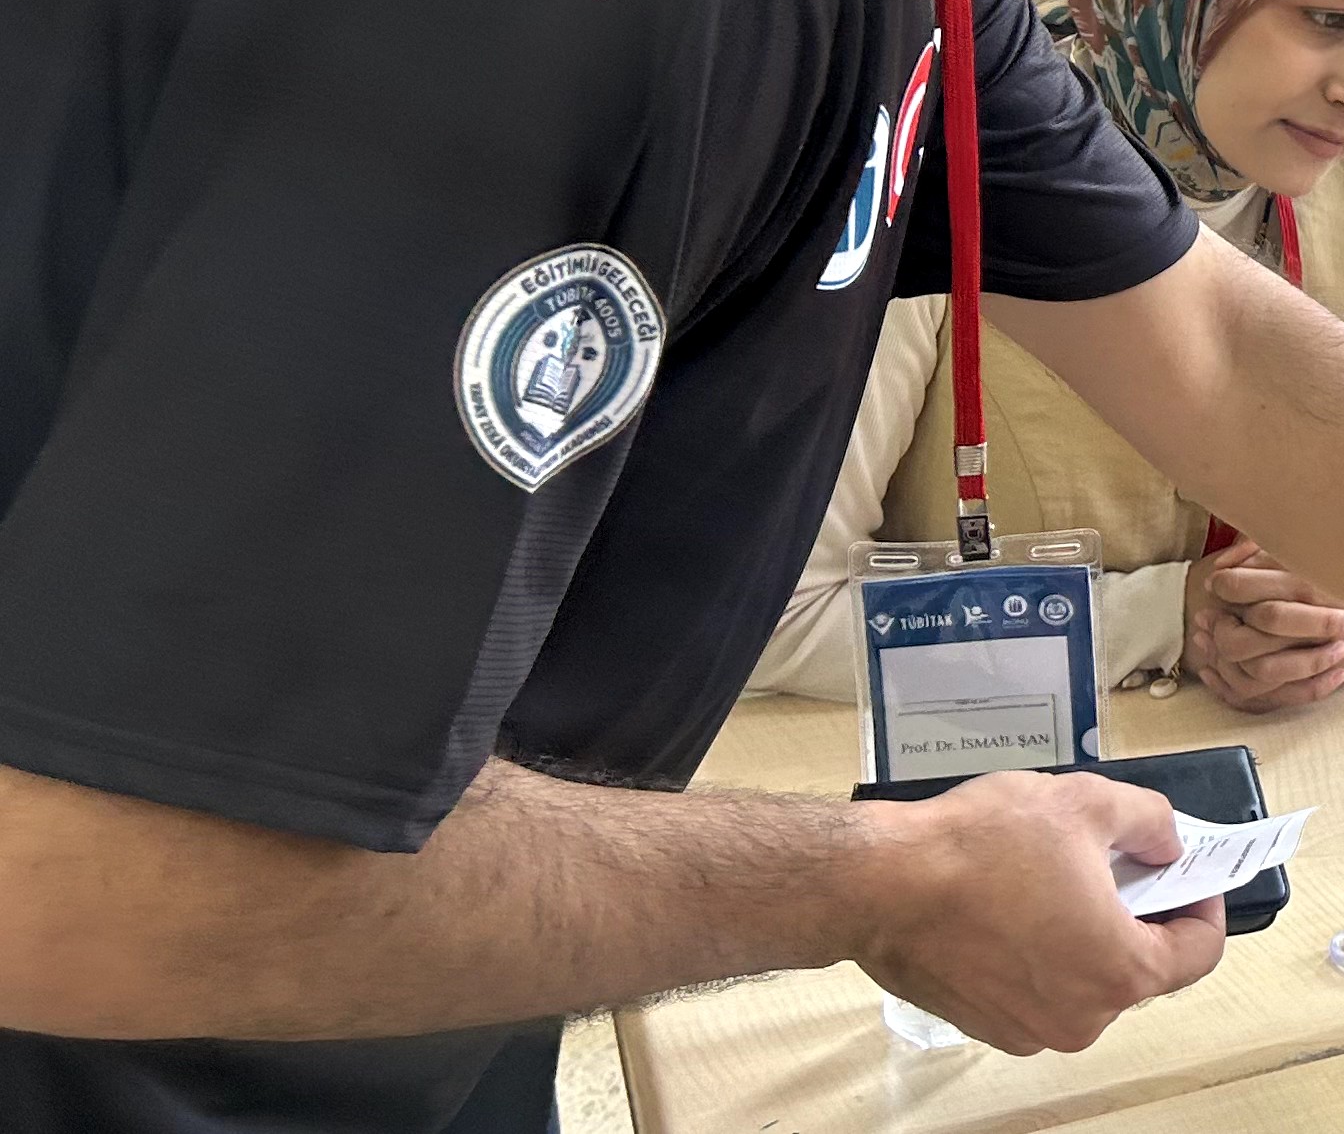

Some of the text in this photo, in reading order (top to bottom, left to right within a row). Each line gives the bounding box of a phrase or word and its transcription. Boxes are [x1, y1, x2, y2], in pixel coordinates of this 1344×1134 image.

[900, 740, 932, 755] Prof.
[935, 739, 957, 753] Dr.
[1017, 732, 1050, 749] ŞAN
